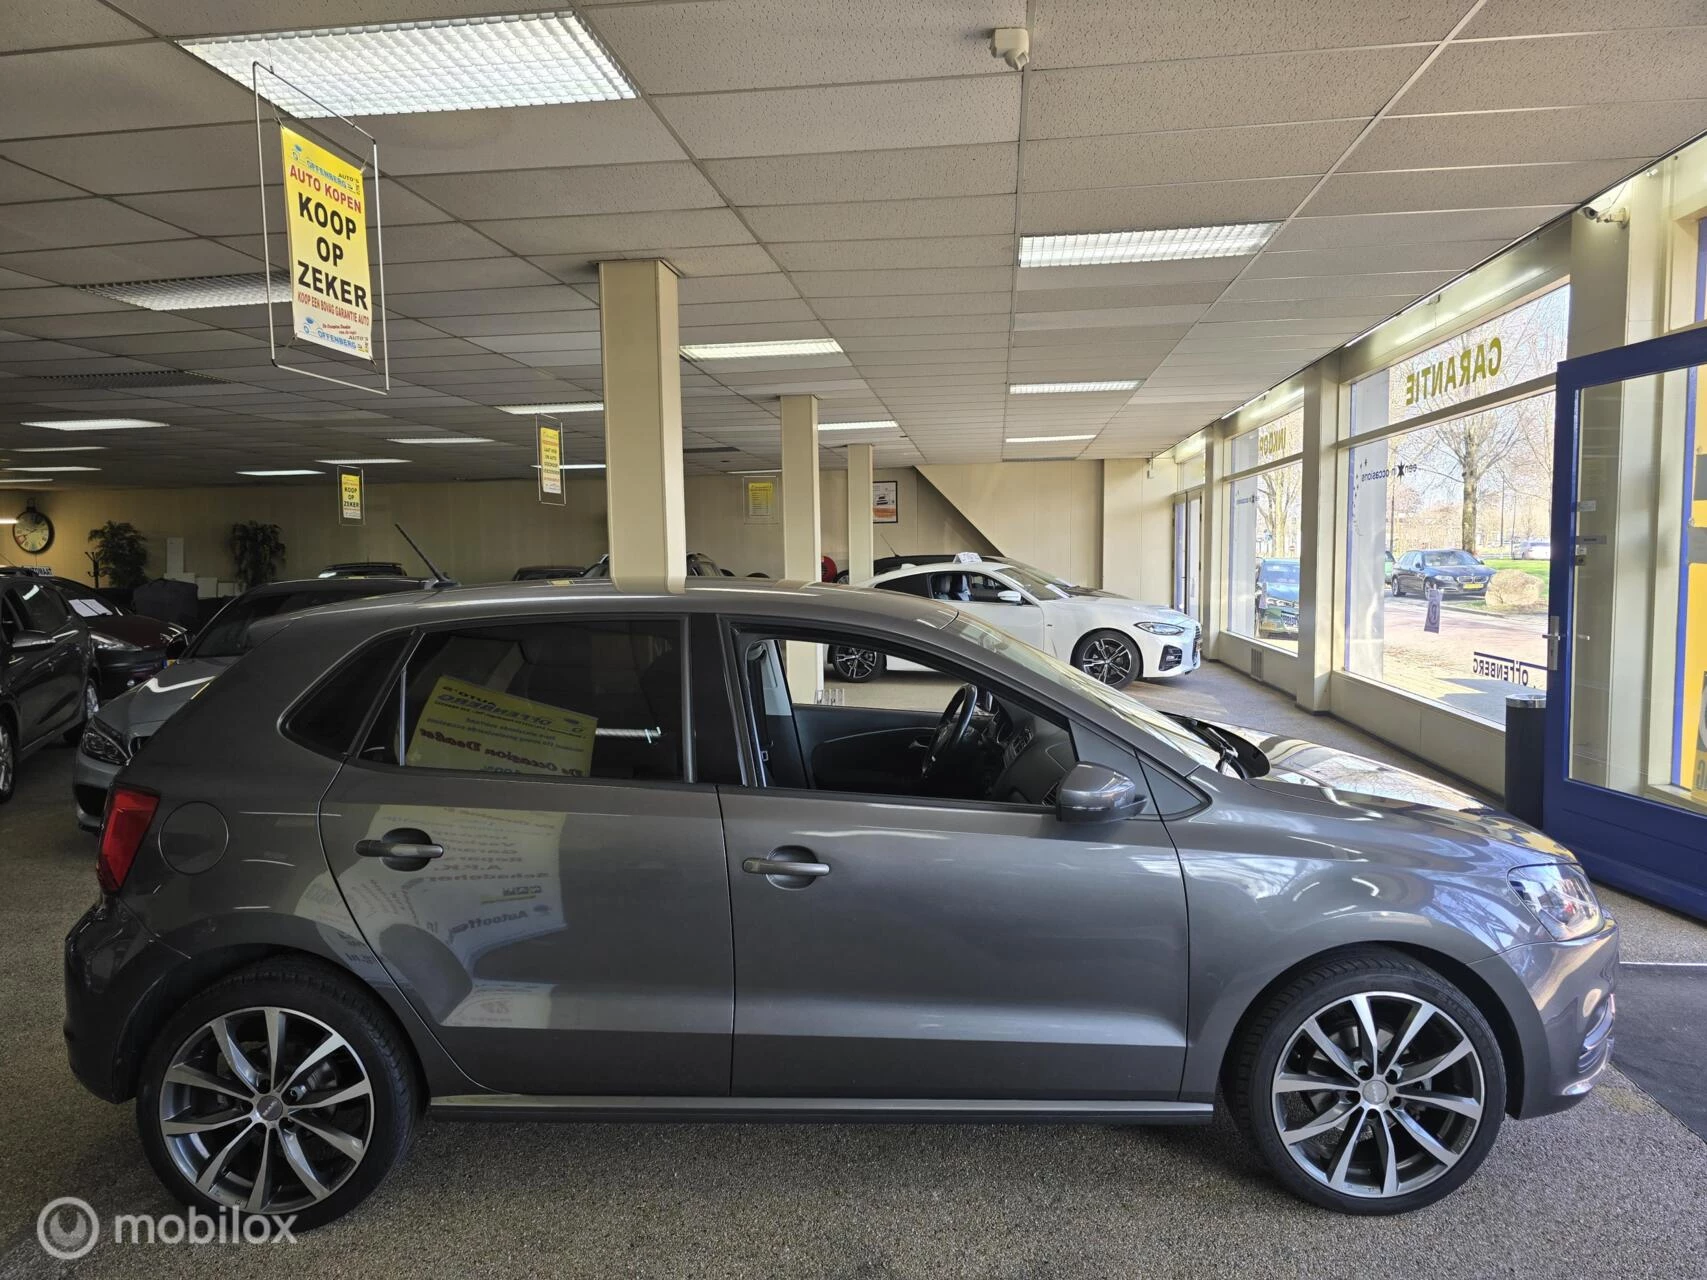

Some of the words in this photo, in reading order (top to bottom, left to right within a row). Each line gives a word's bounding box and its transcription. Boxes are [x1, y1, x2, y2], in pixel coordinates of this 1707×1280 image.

[290, 165, 321, 192] AUTO
[325, 183, 362, 214] KOPEN
[298, 192, 357, 240] KOOP
[316, 236, 344, 267] OP
[297, 260, 369, 311] ZEKER
